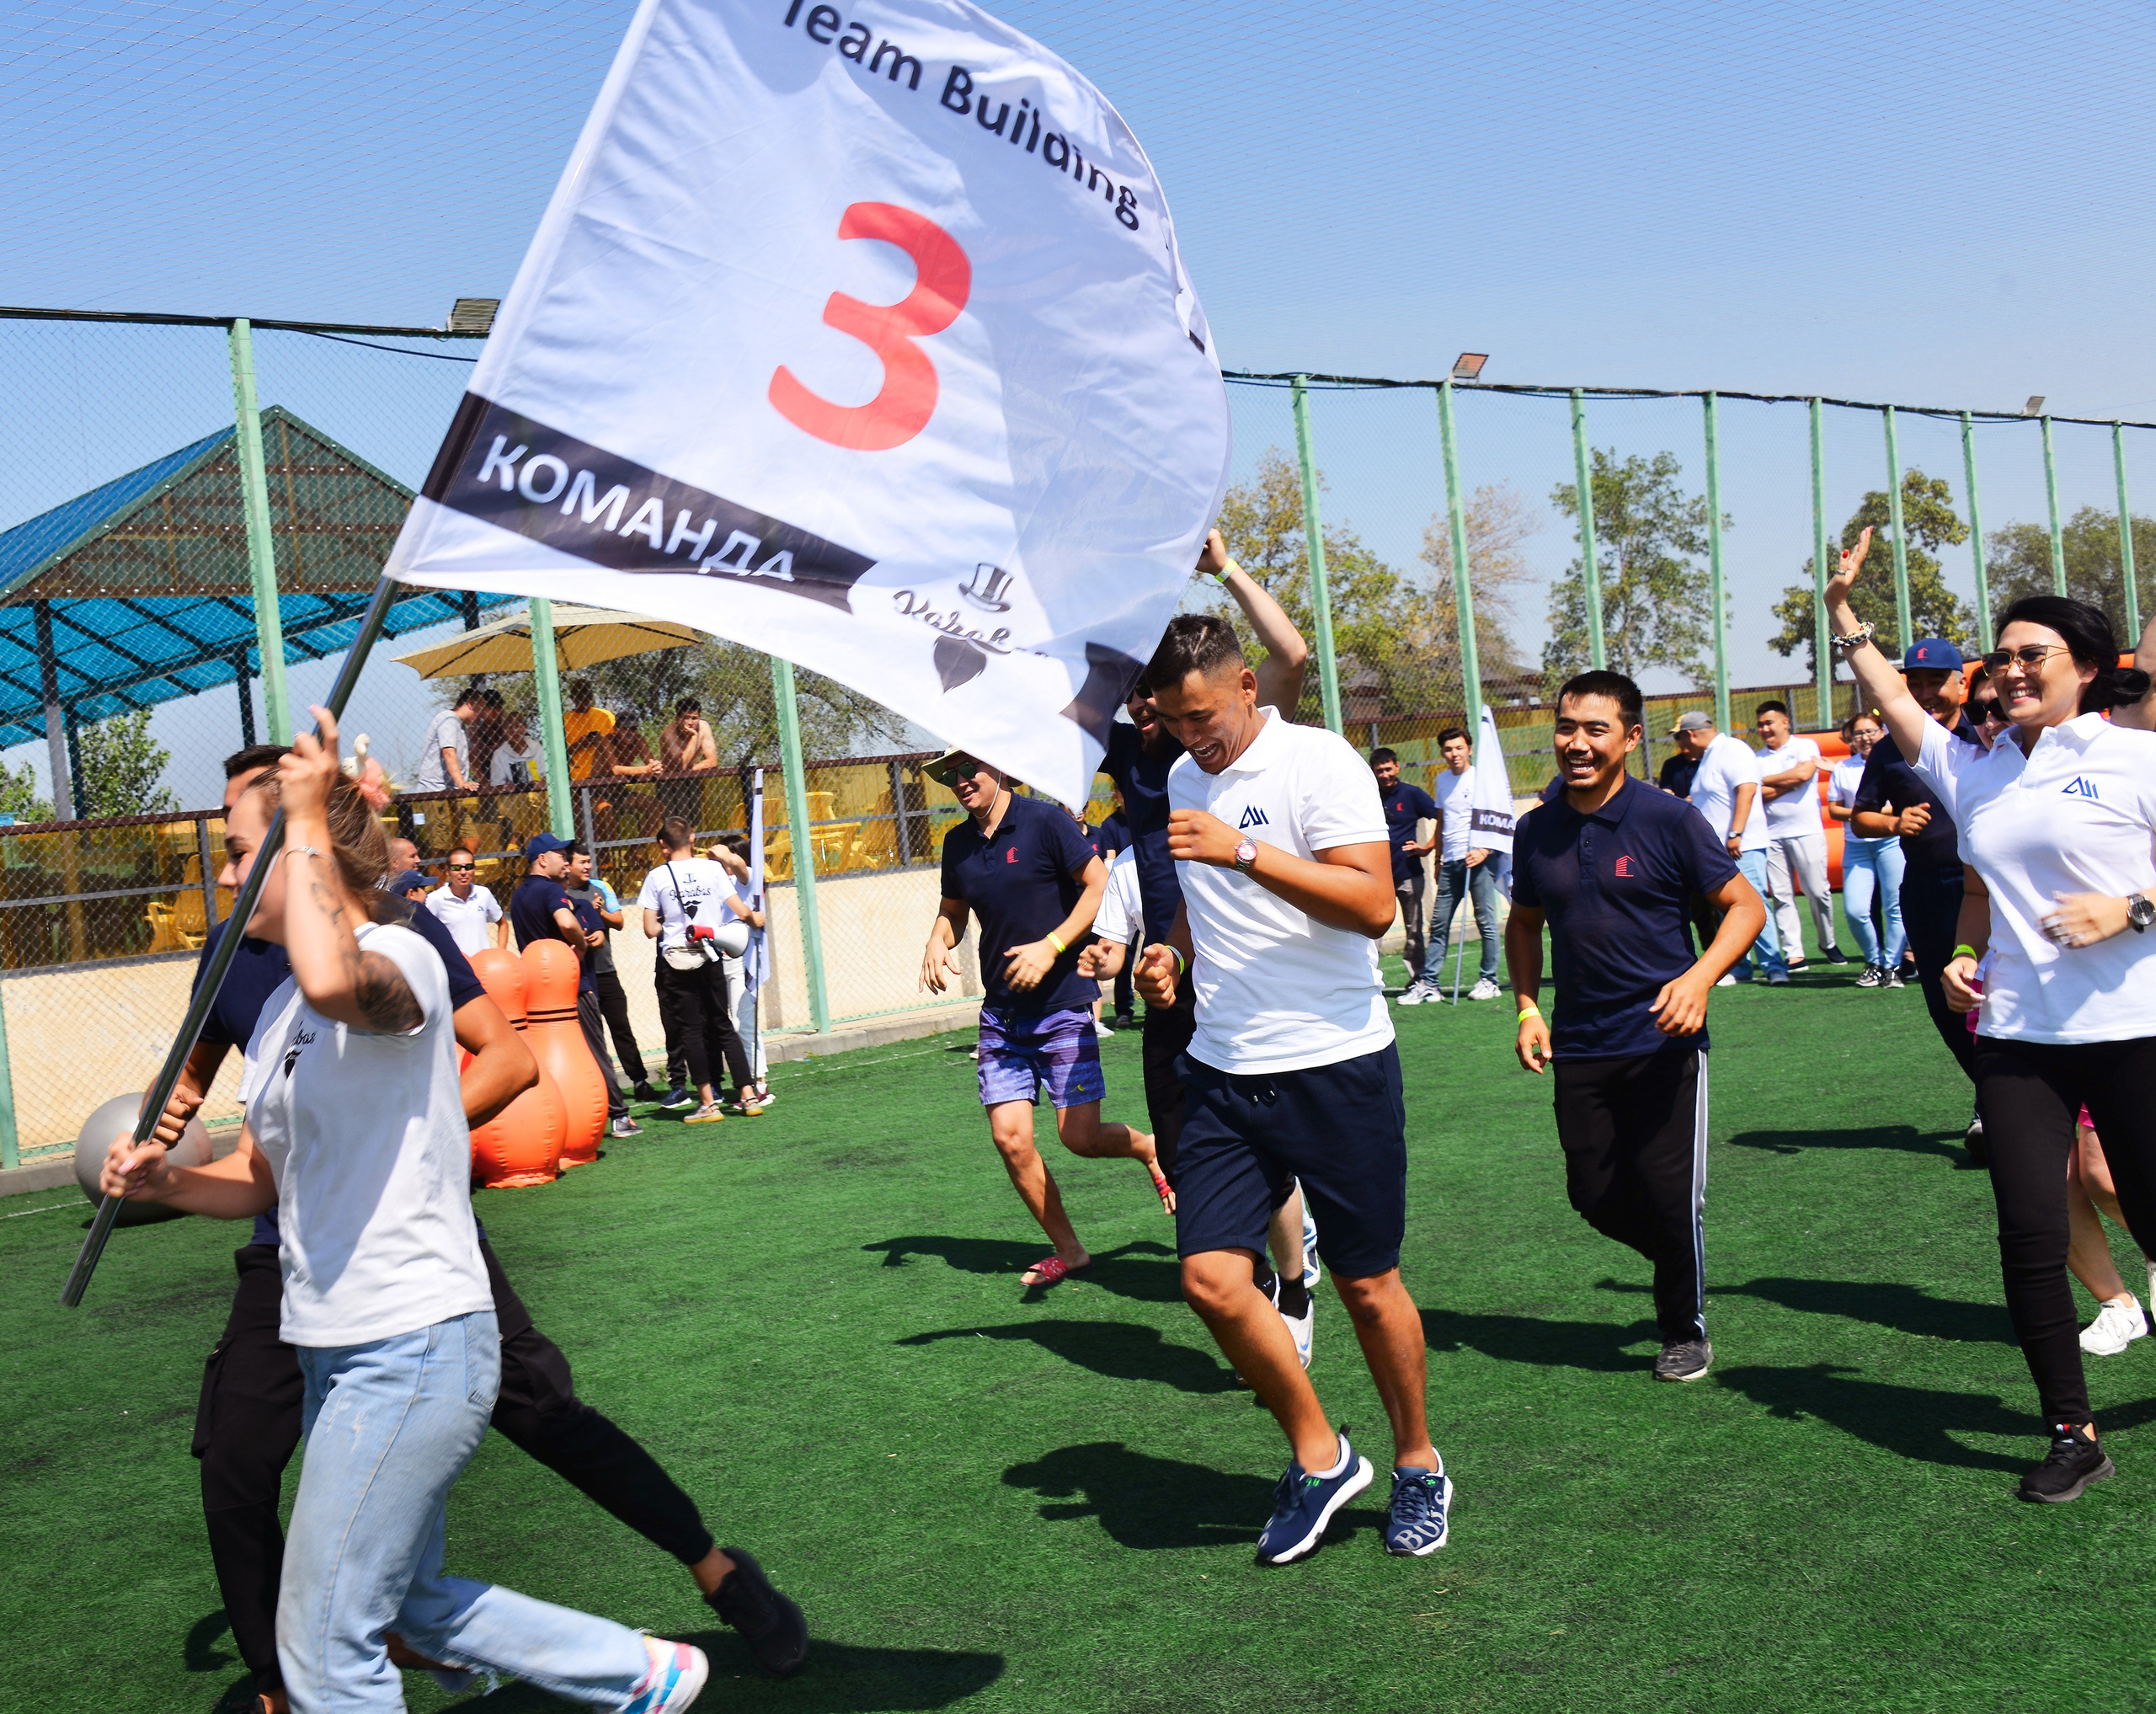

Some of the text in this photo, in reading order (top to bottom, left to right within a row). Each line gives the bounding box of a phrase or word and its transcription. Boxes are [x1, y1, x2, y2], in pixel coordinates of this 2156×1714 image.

[939, 65, 1139, 232] Building
[768, 201, 972, 451] 3
[477, 434, 795, 582] КОМАНДА
[1479, 814, 1516, 831] КОМА
